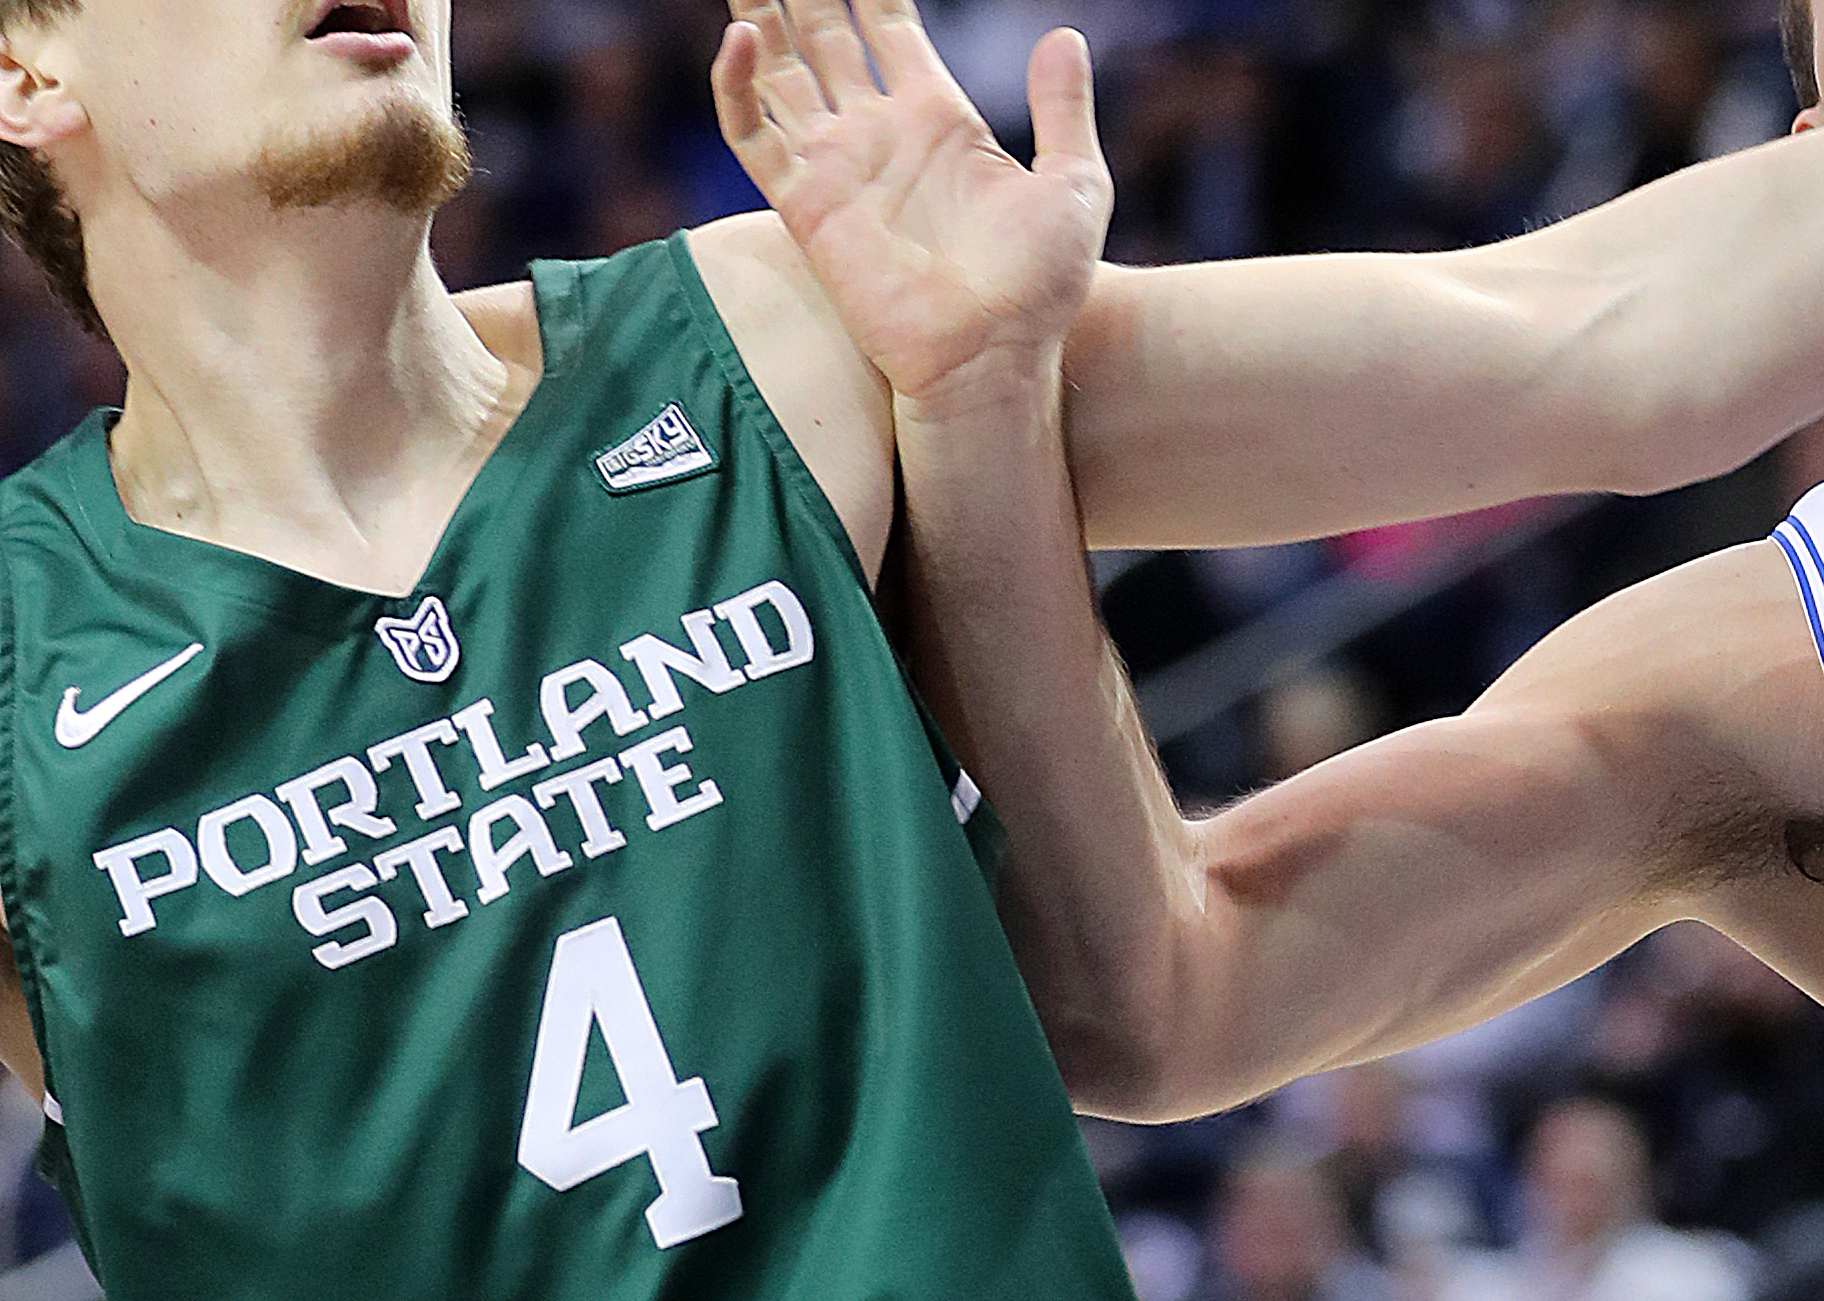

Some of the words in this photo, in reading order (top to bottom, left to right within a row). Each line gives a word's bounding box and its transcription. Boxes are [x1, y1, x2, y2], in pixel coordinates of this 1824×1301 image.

[92, 578, 815, 938] PORTLAND
[292, 725, 724, 970] STATE
[517, 915, 744, 1250] 4
